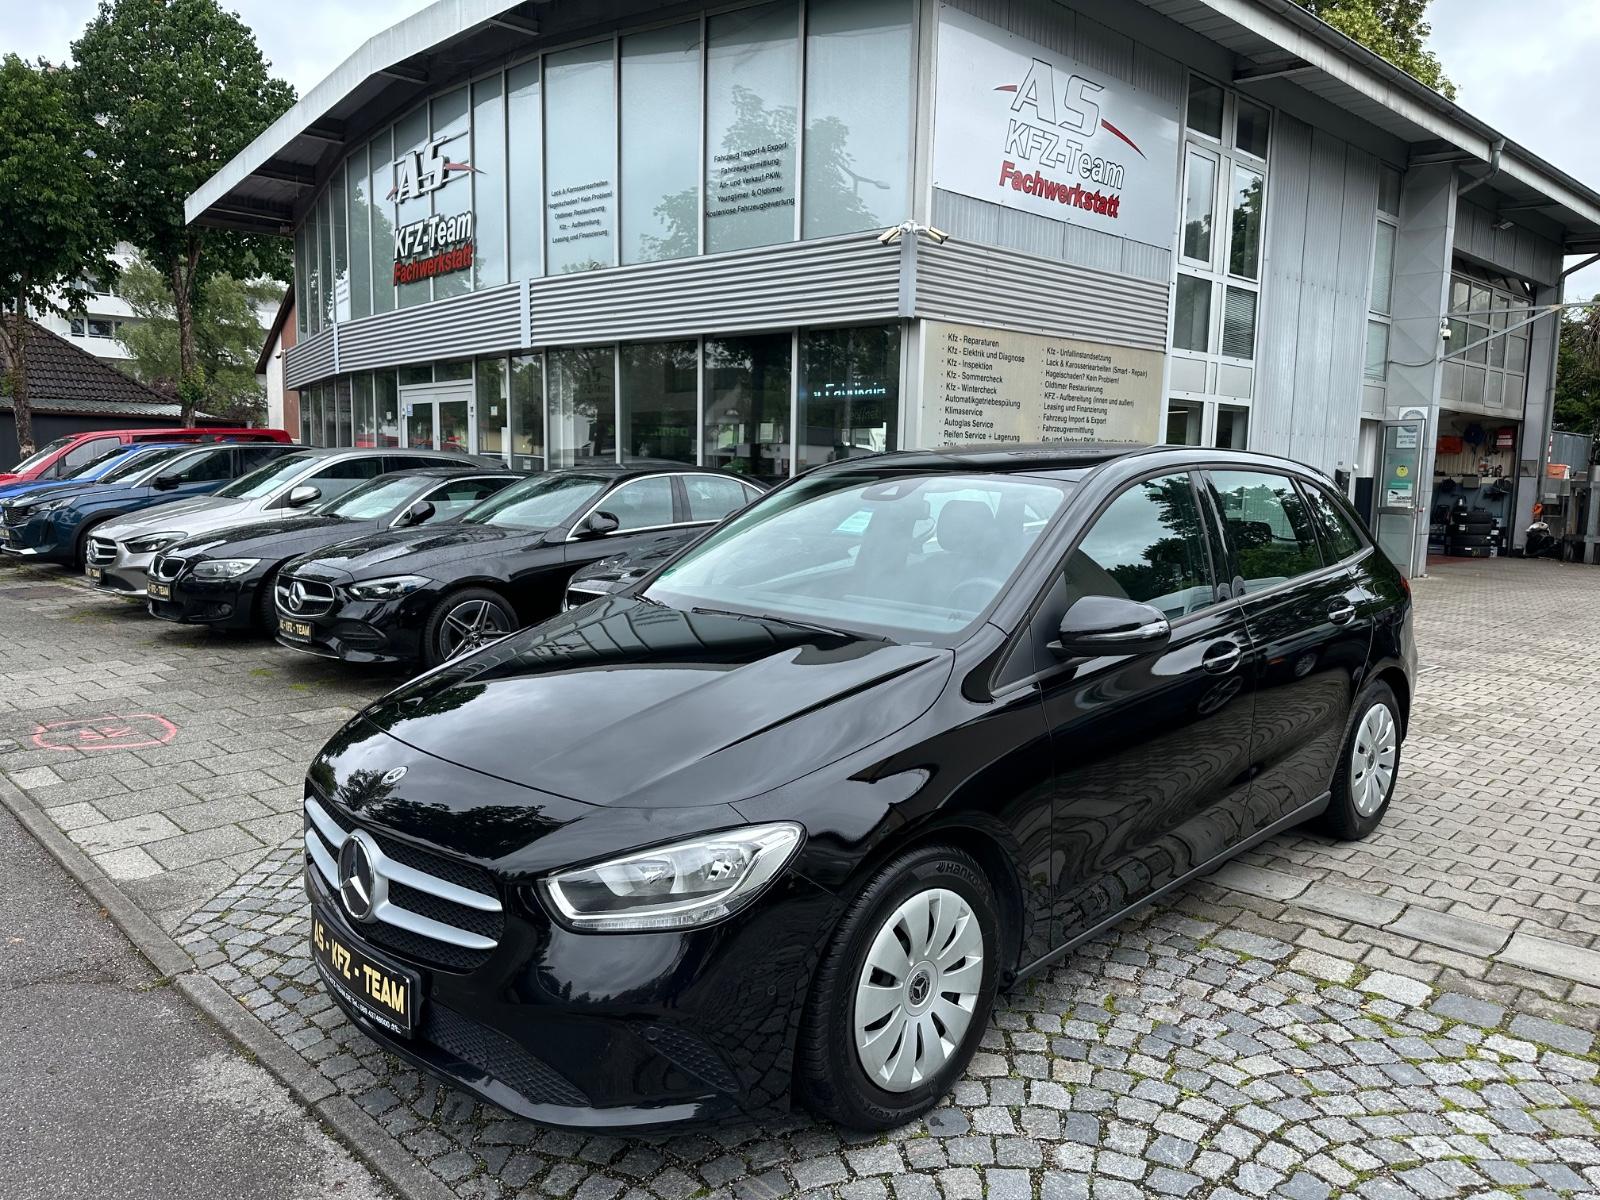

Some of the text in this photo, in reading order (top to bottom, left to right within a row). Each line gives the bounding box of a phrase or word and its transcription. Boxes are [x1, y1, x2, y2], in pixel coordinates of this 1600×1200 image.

[1010, 57, 1105, 137] AS
[714, 152, 740, 162] Fahrzeug
[741, 148, 760, 157] Import
[767, 142, 787, 152] Export
[1005, 118, 1125, 190] KFZ-Team
[395, 136, 449, 204] AS
[721, 158, 780, 174] Fahrzeugvermittlung
[742, 174, 764, 184] Verkauf
[718, 192, 748, 202] Youngtimer
[757, 186, 782, 196] Oldtimer
[999, 160, 1120, 218] Fachwerkstatt
[706, 198, 795, 218] Kostenlose Fahrzeugbewertung
[394, 211, 472, 261] KFZ-Team
[394, 239, 473, 286] Fachwerkstatt
[948, 333, 958, 342] Kfz
[963, 335, 1000, 347] Reparaturen
[948, 346, 958, 354] Kfz
[963, 348, 985, 358] Elektrik
[986, 351, 997, 360] und
[999, 352, 1025, 363] Diagnose
[1046, 347, 1056, 355] Kfz
[1060, 348, 1112, 363] Unfallinstandsetzung
[947, 358, 957, 367] Kfz
[963, 360, 992, 370] Inspektion
[1046, 359, 1058, 367] Lack
[1065, 361, 1112, 373] Karosseriearbeiten
[1112, 366, 1127, 375] (Smart
[1131, 368, 1147, 378] Repair)
[946, 370, 957, 379] Kfz
[962, 372, 1003, 383] Sommercheck
[1046, 370, 1120, 384] Hagelschaden? Kein Problem!
[946, 382, 956, 391] Kfz
[962, 384, 997, 394] Wintercheck
[1045, 381, 1103, 395] Oldtimer Restaurierung
[945, 394, 1021, 409] Automatikgetriebespülung
[1044, 392, 1055, 400] KFZ
[1060, 393, 1091, 404] Aufbereitung
[945, 406, 983, 416] Klimaservice
[1044, 403, 1064, 412] Leasing
[1076, 405, 1108, 415] Finanzierung
[944, 418, 994, 428] Autoglas Service
[1043, 414, 1067, 423] Fahrzeug
[1068, 415, 1085, 424] Import
[1091, 416, 1106, 425] Export
[944, 430, 963, 439] Reifen
[965, 431, 986, 440] Service
[994, 433, 1020, 442] Lagerung
[1042, 424, 1094, 435] Fahrzeugvermittlung
[296, 624, 310, 636] TEAM
[314, 919, 324, 952] AS
[331, 938, 351, 980] KFZ
[363, 964, 405, 1015] TEAM
